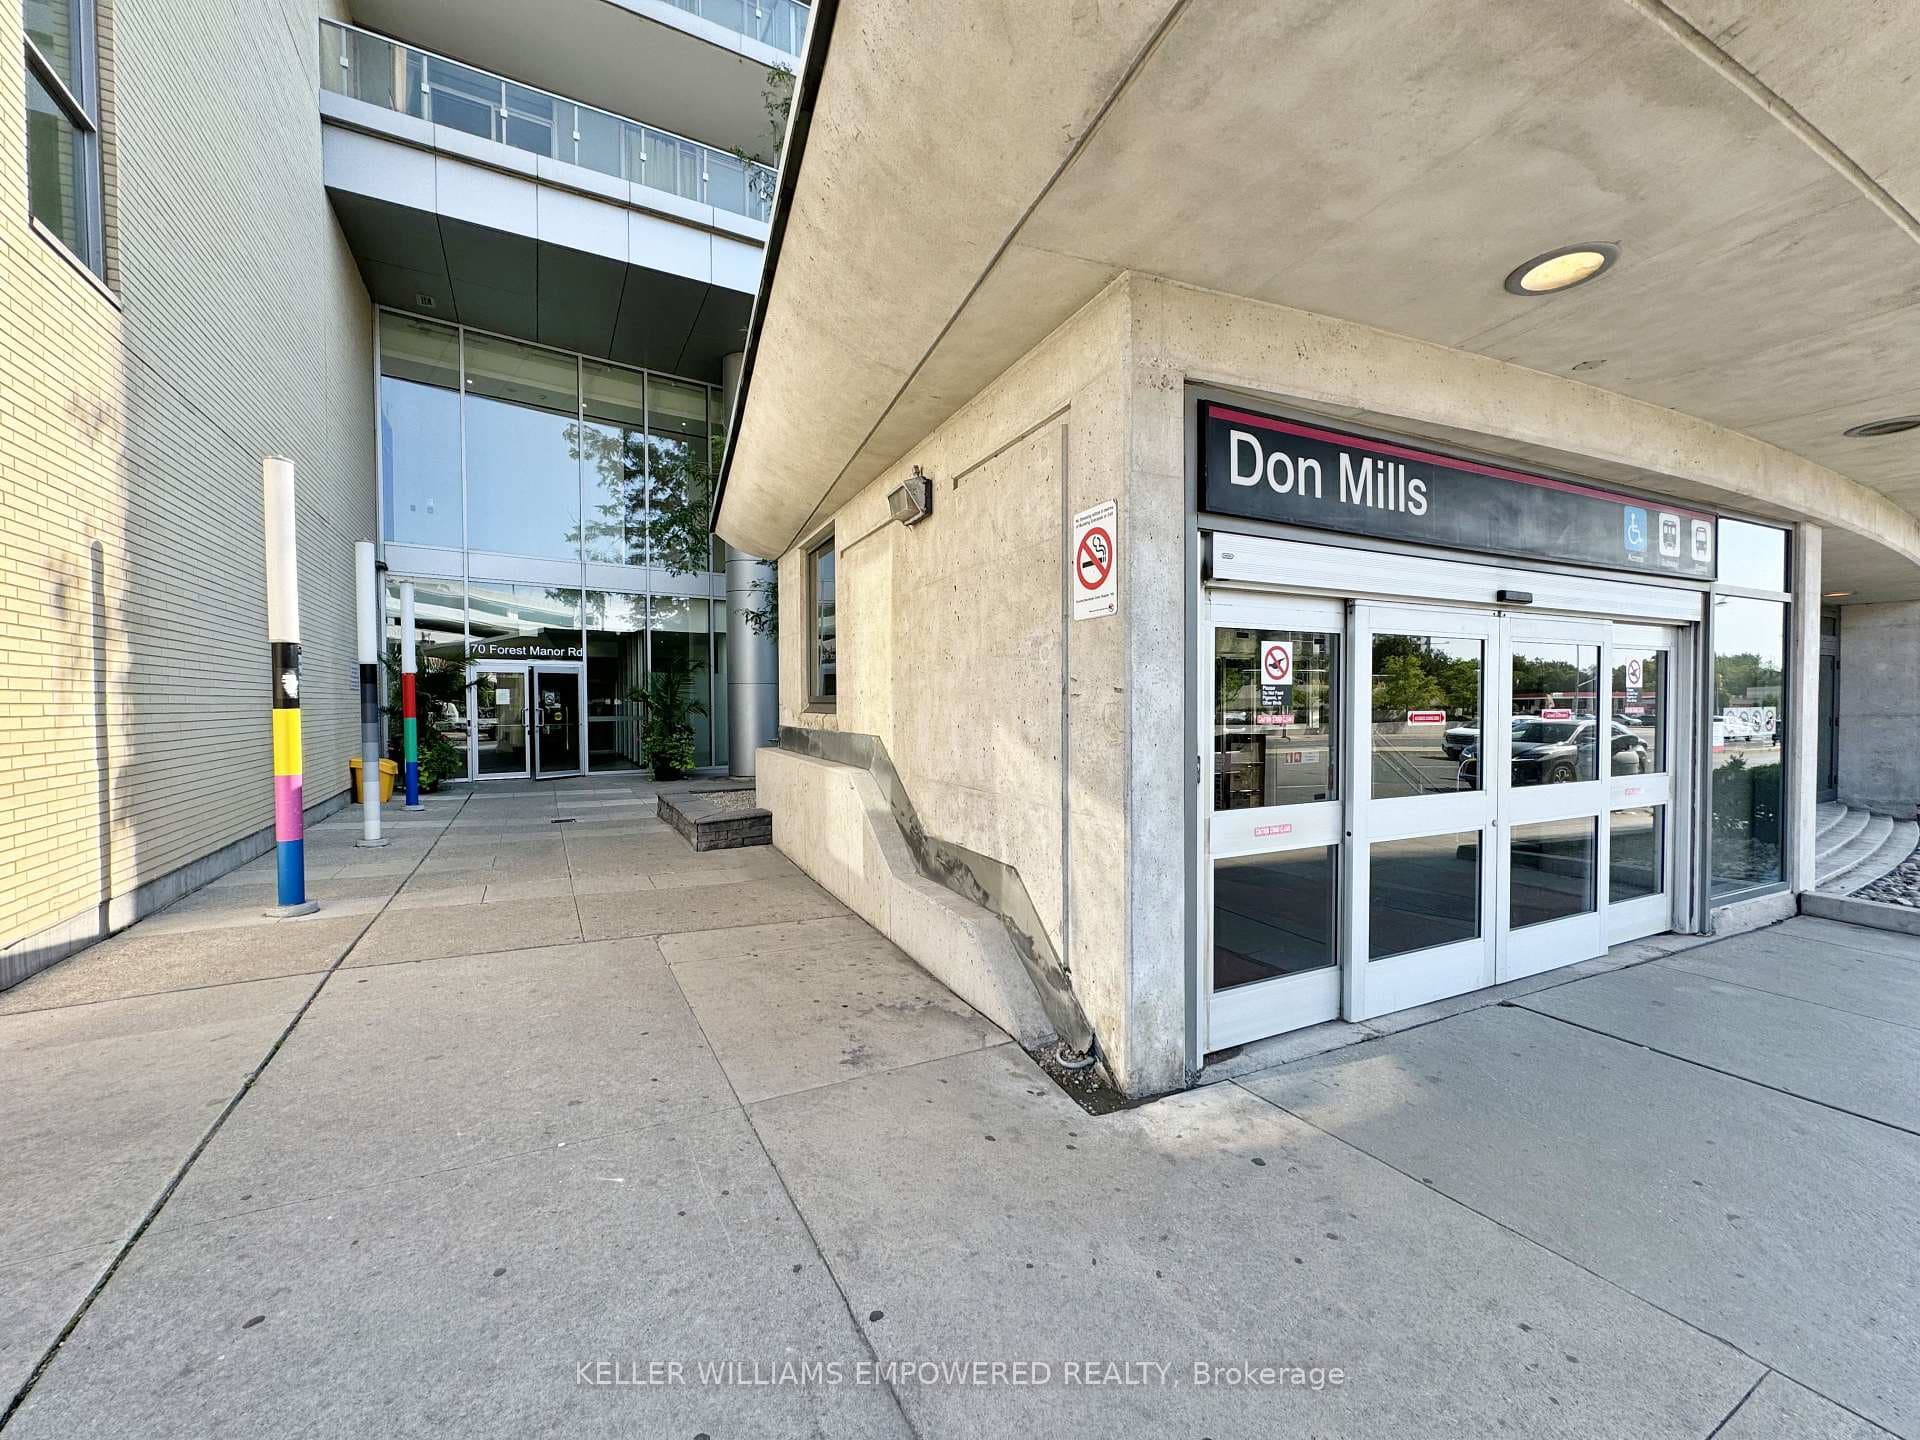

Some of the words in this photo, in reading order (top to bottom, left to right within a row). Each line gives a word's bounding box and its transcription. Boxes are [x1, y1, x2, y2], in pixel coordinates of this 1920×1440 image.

[1230, 430, 1322, 499] Don
[1339, 452, 1428, 516] Mills
[471, 644, 485, 654] 70
[490, 644, 527, 656] Forest
[529, 645, 566, 657] Manor
[568, 647, 583, 657] Rd
